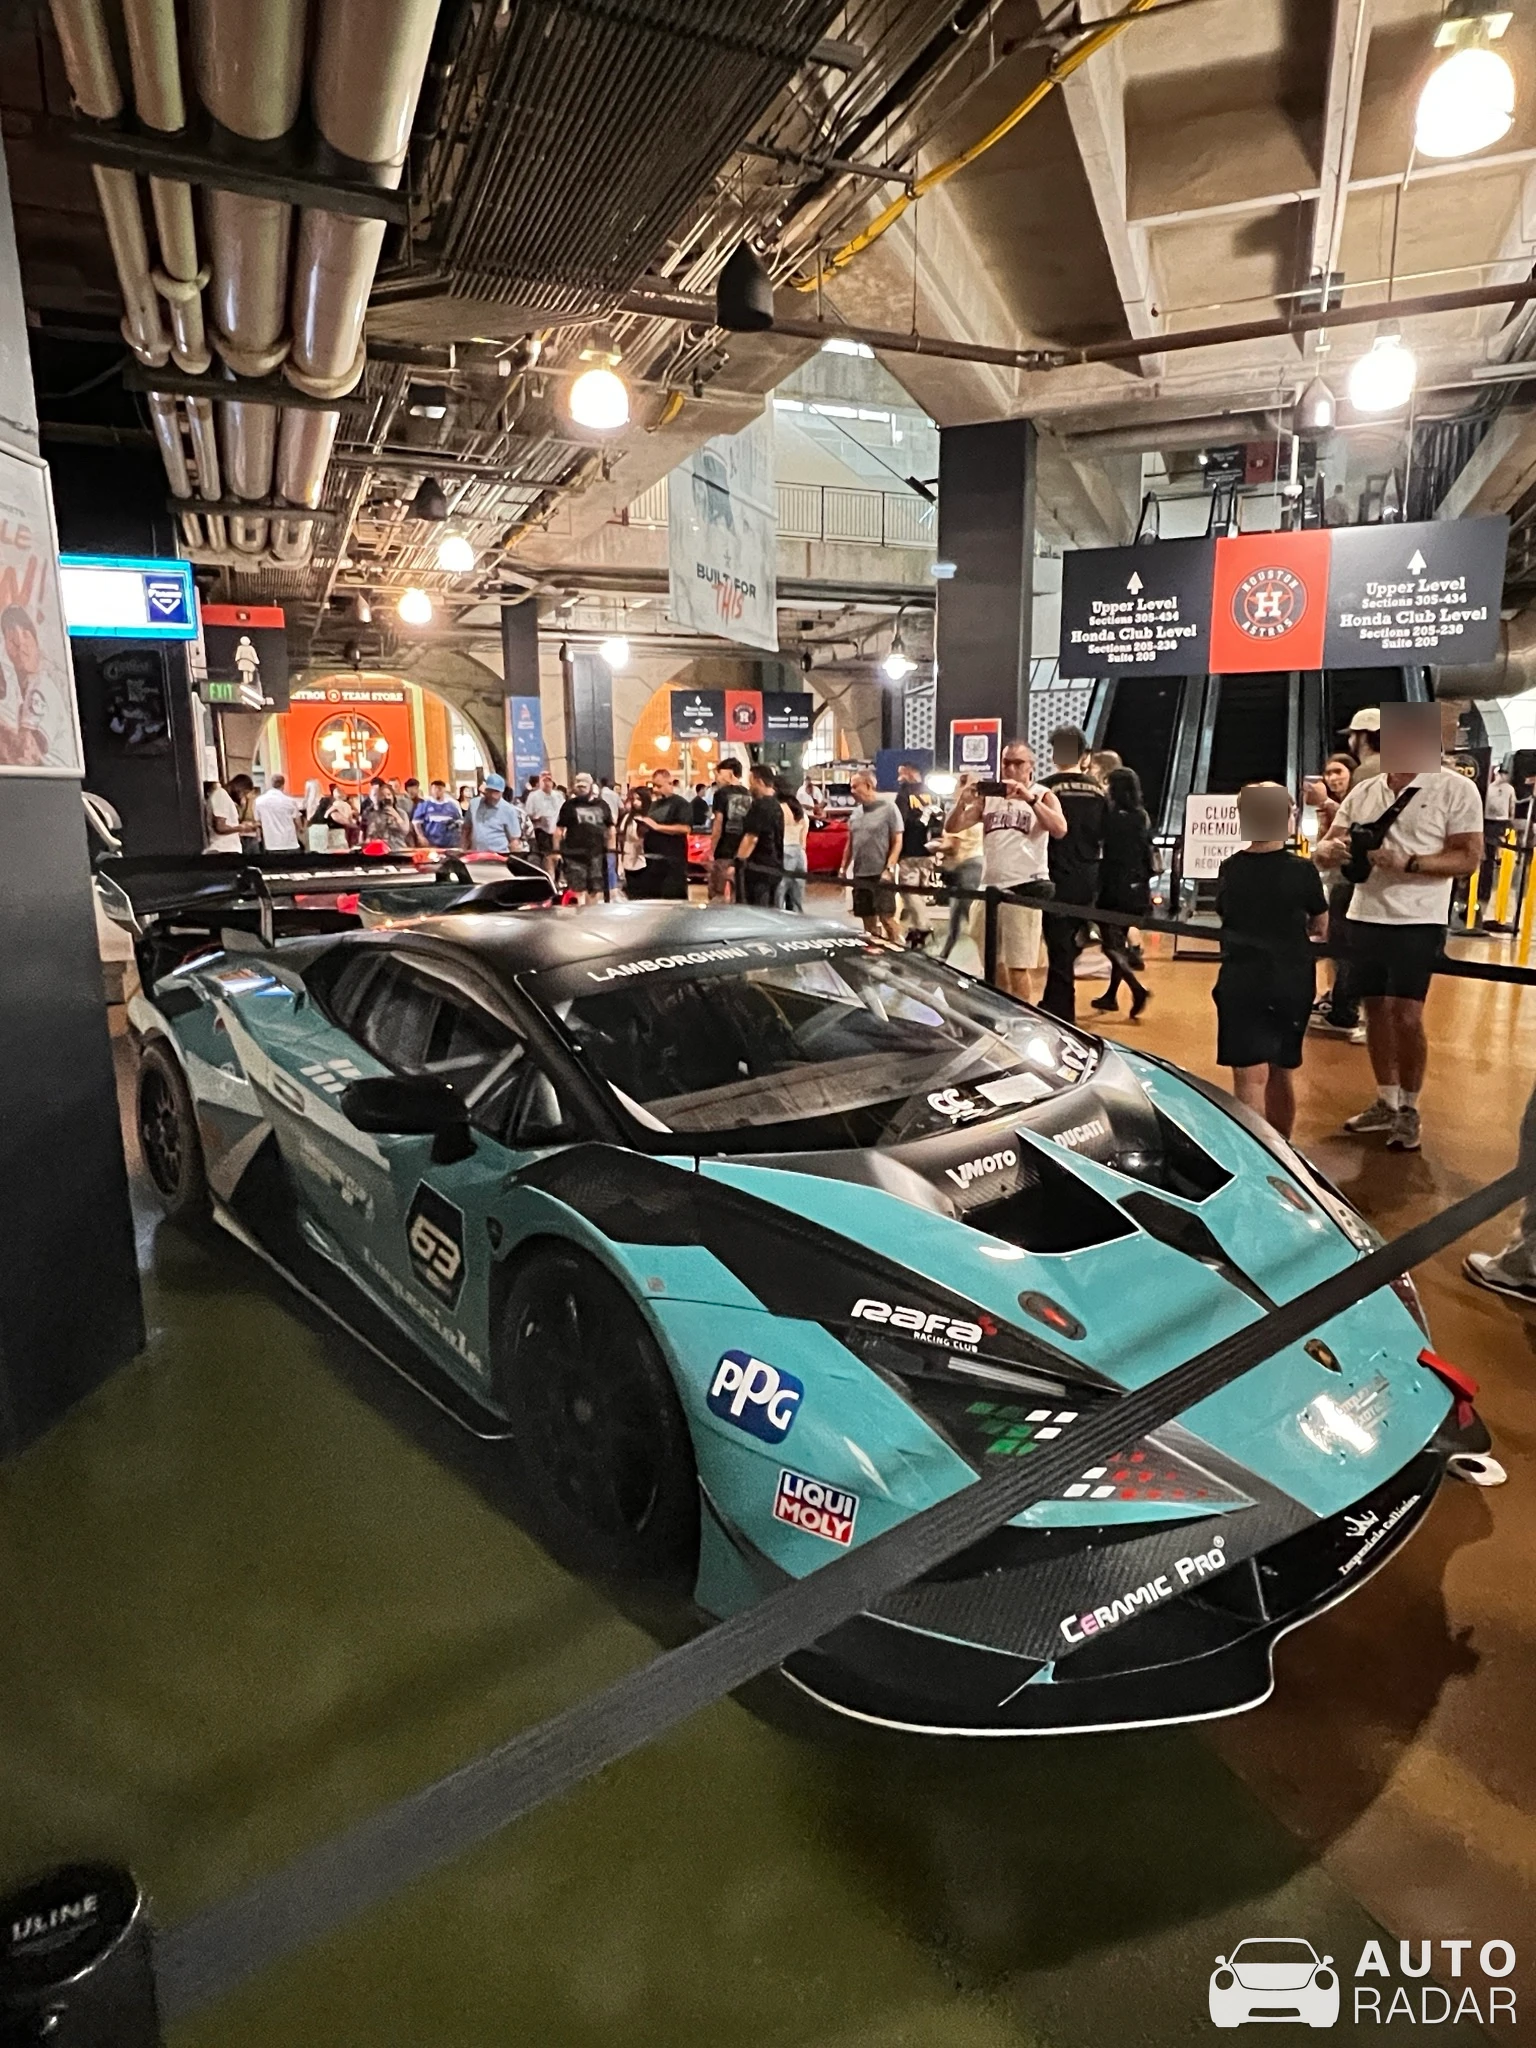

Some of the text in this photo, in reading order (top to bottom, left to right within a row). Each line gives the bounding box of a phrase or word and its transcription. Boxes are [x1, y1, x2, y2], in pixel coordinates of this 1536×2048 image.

[696, 561, 756, 599] BUILT FOR
[1241, 569, 1299, 592] HOUSTON
[1366, 576, 1466, 598] Upper Level
[711, 578, 745, 626] THIS
[1092, 596, 1178, 616] Upper Level
[1254, 591, 1283, 617] H
[1362, 592, 1467, 609] Sections 305-434
[1089, 611, 1179, 626] Sections 305-434
[1340, 606, 1488, 627] Honda Club Level
[1070, 624, 1197, 643] Honda Club Level
[1241, 618, 1293, 637] ASTROS
[1360, 627, 1411, 639] Sections
[1088, 643, 1132, 654] Sections
[1382, 636, 1439, 649] Suite 205
[1108, 651, 1156, 663] Suite 205
[209, 683, 232, 699] EXIT
[342, 691, 371, 701] TEAM
[371, 692, 404, 702] STORE
[1205, 806, 1237, 820] CLUB
[1191, 822, 1240, 835] PREMIU
[1195, 857, 1219, 869] REQU
[587, 938, 868, 982] LAMBORGHINI HOUSTON
[1053, 1119, 1104, 1149] DUCATI
[913, 1331, 979, 1353] RACING CLUB
[711, 1357, 800, 1431] PPG
[783, 1473, 852, 1518] LIQUI
[778, 1496, 851, 1540] MOLY
[12, 1894, 98, 1942] ULINE
